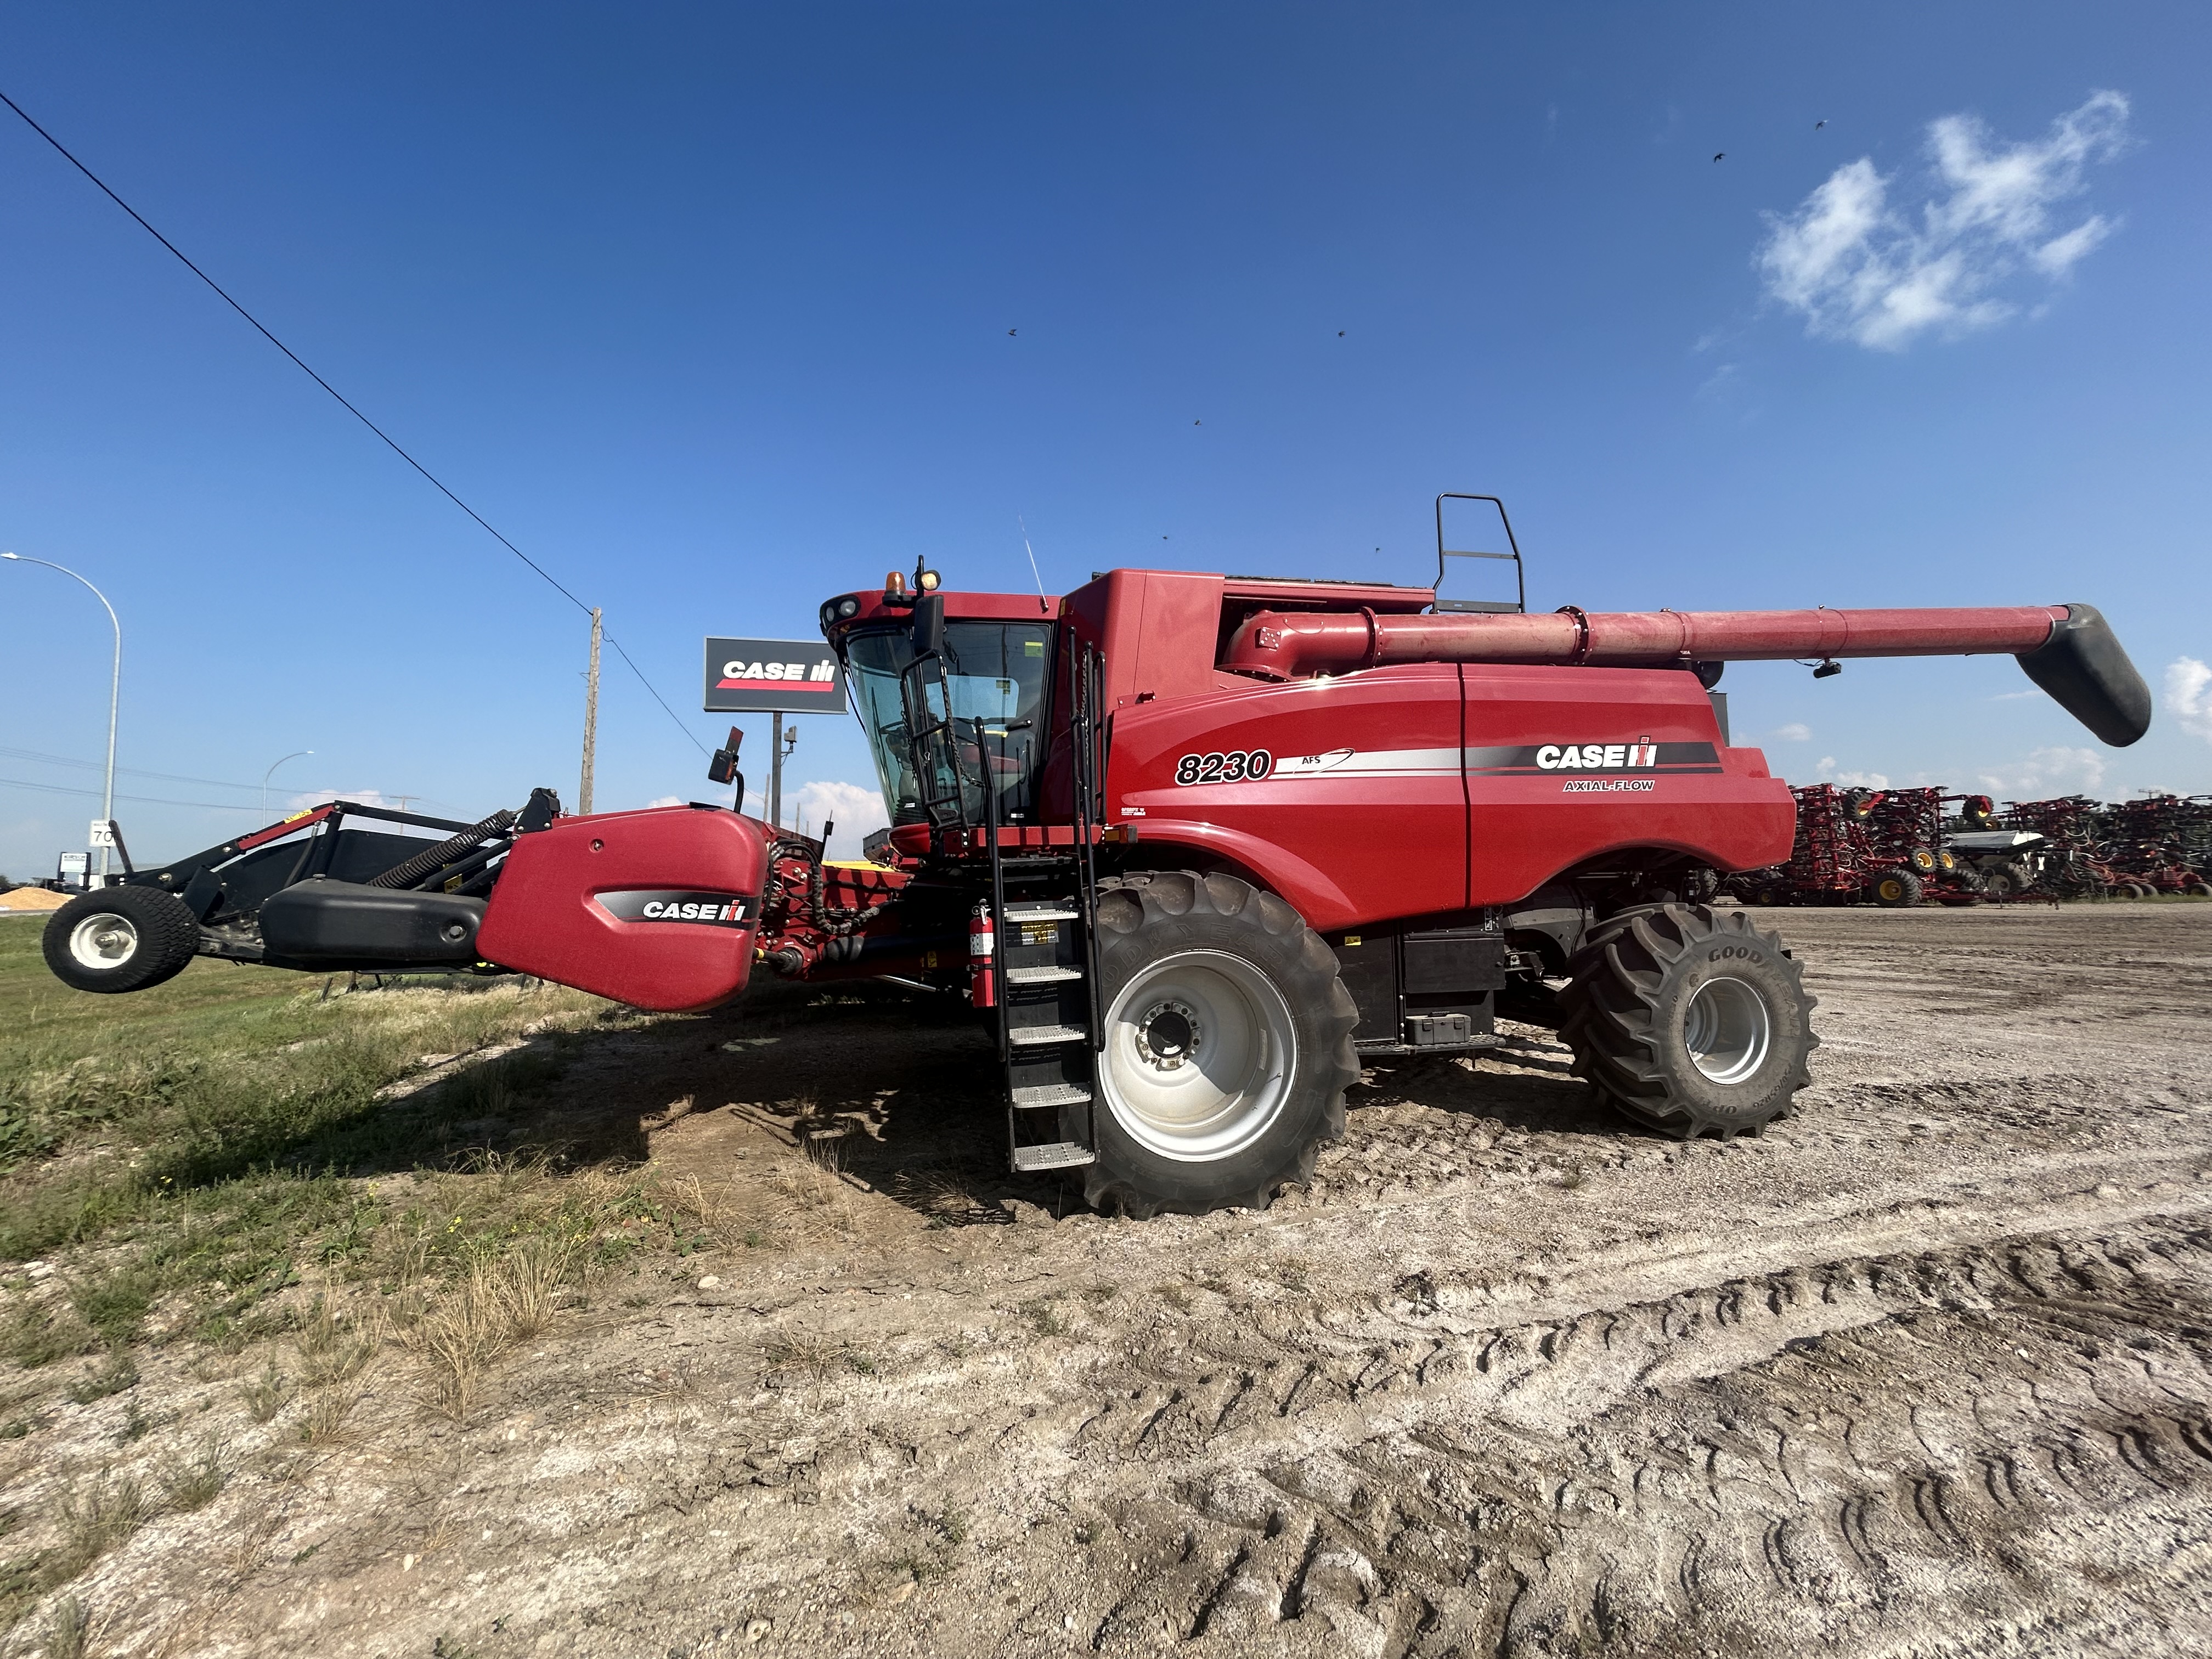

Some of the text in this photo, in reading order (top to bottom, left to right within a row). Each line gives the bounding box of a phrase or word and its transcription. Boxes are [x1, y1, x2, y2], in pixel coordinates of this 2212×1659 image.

[723, 661, 805, 680] CASE
[1301, 755, 1321, 765] AFS
[1536, 745, 1626, 769] CASE
[1175, 749, 1271, 786] 8230
[1562, 779, 1656, 792] AXIAL-FLOW
[93, 831, 114, 842] 70
[643, 901, 719, 919] CASE
